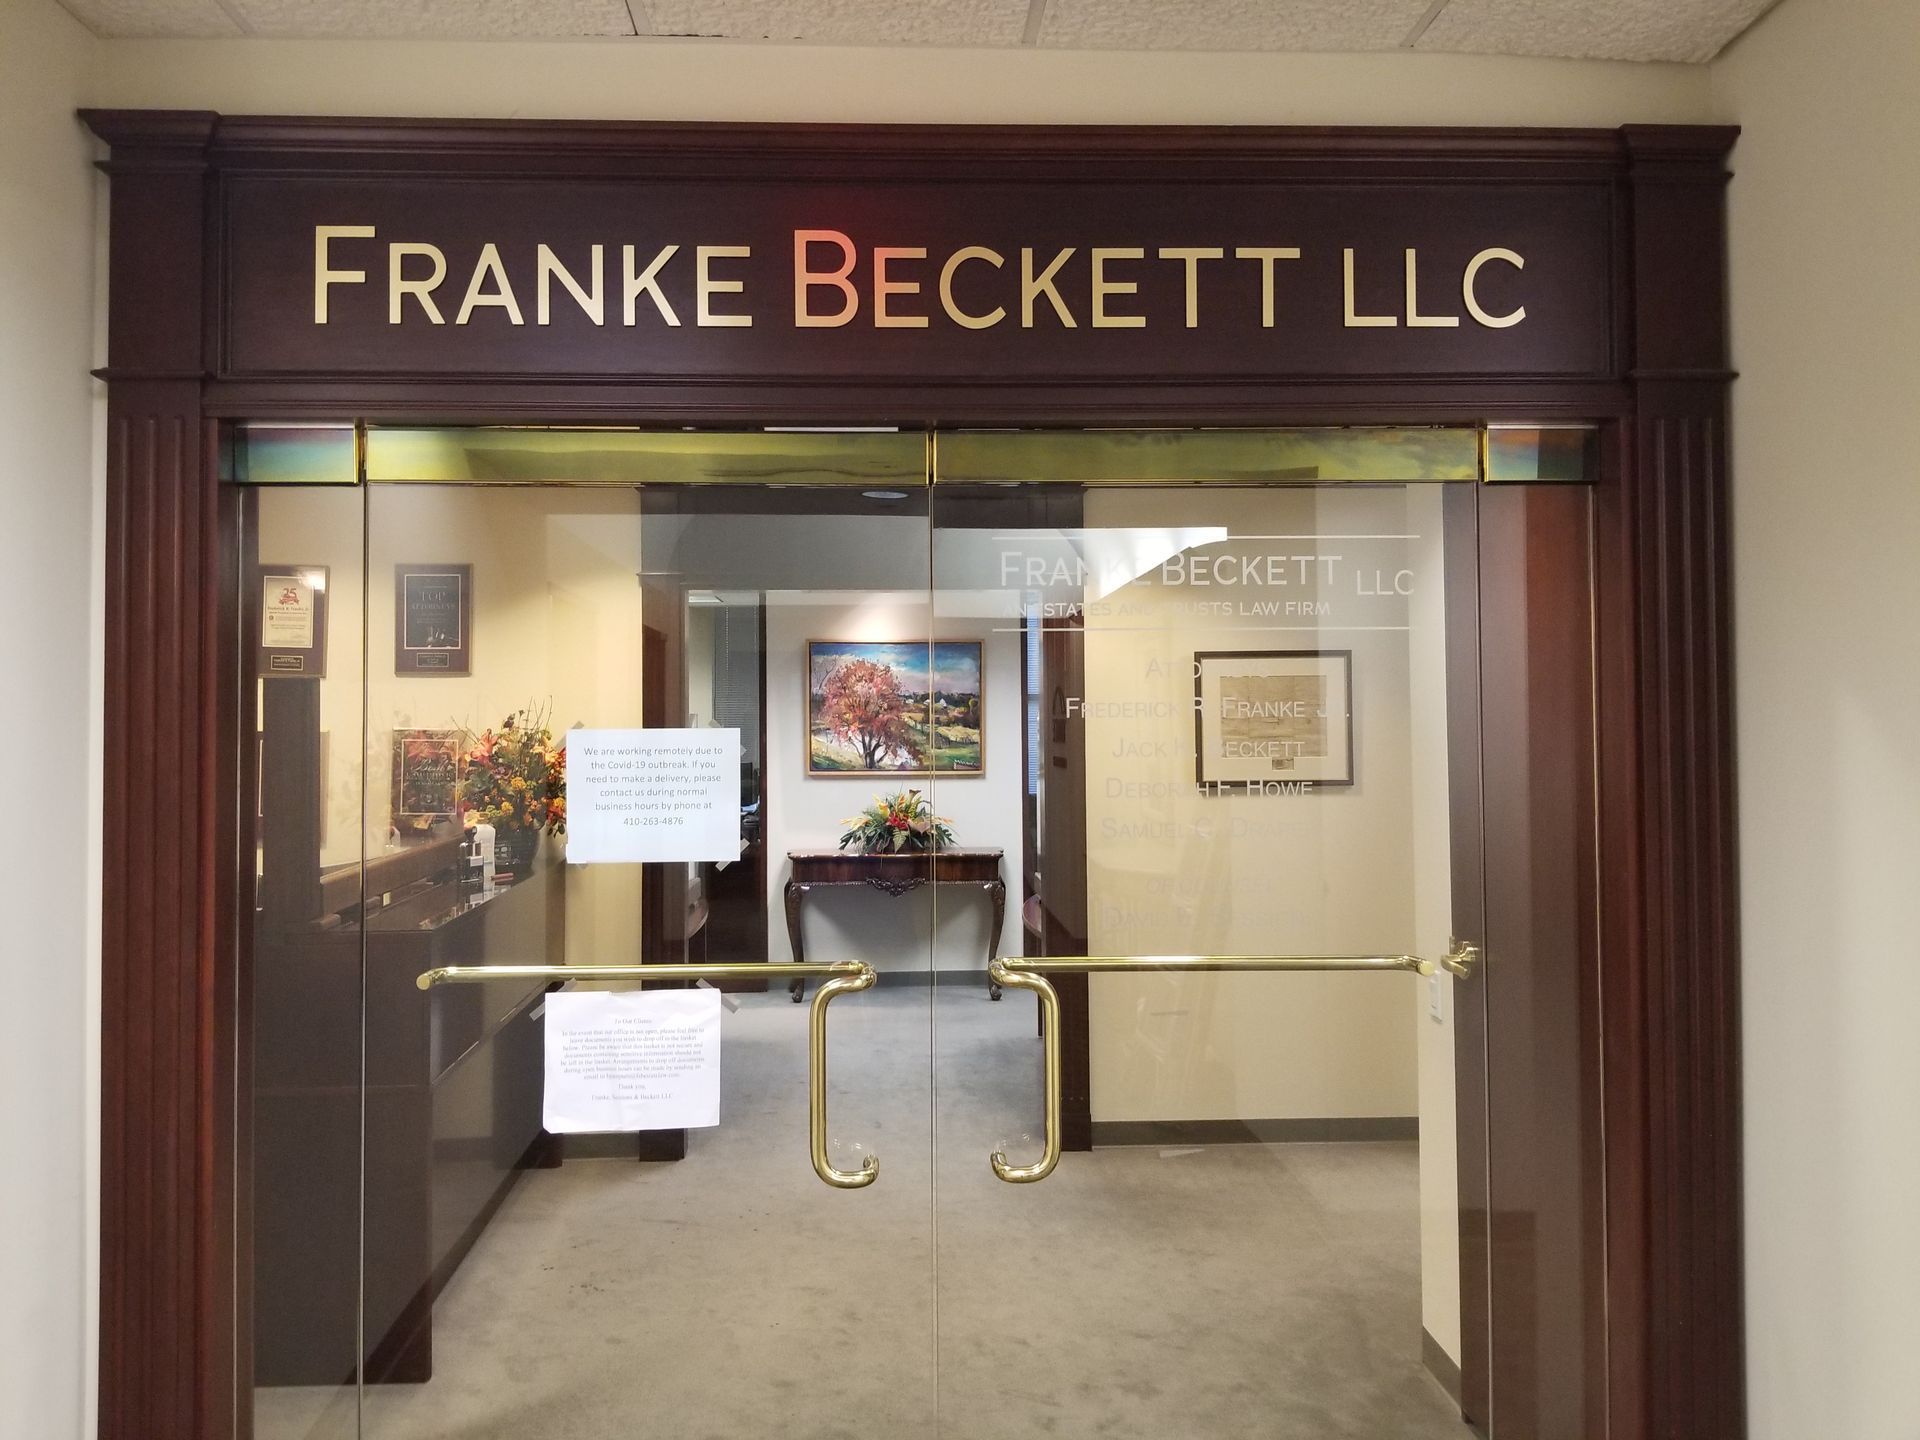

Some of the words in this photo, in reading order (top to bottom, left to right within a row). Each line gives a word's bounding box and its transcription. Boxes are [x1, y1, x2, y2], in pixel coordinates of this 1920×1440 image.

[314, 225, 752, 328] FRANKE
[794, 229, 1301, 329] BECKETT
[1343, 247, 1527, 329] LLC
[1161, 552, 1342, 586] BECKETT
[1356, 569, 1415, 596] LLC
[1239, 602, 1279, 616] LAW
[1285, 601, 1331, 616] FIRM
[584, 748, 599, 756] We
[617, 748, 651, 756] working
[654, 747, 692, 755] remotely
[608, 761, 645, 769] Covid-19
[648, 761, 689, 769] outbreak.
[692, 760, 699, 768] If
[586, 775, 607, 783] need
[655, 775, 691, 783] delivery,
[694, 774, 721, 782] please
[600, 789, 632, 797] contact
[647, 789, 674, 797] during
[677, 788, 708, 796] normal
[595, 802, 632, 810] business
[635, 802, 658, 810] hours
[661, 802, 672, 811] by
[674, 802, 701, 810] phone
[624, 817, 684, 826] 410-263-4876
